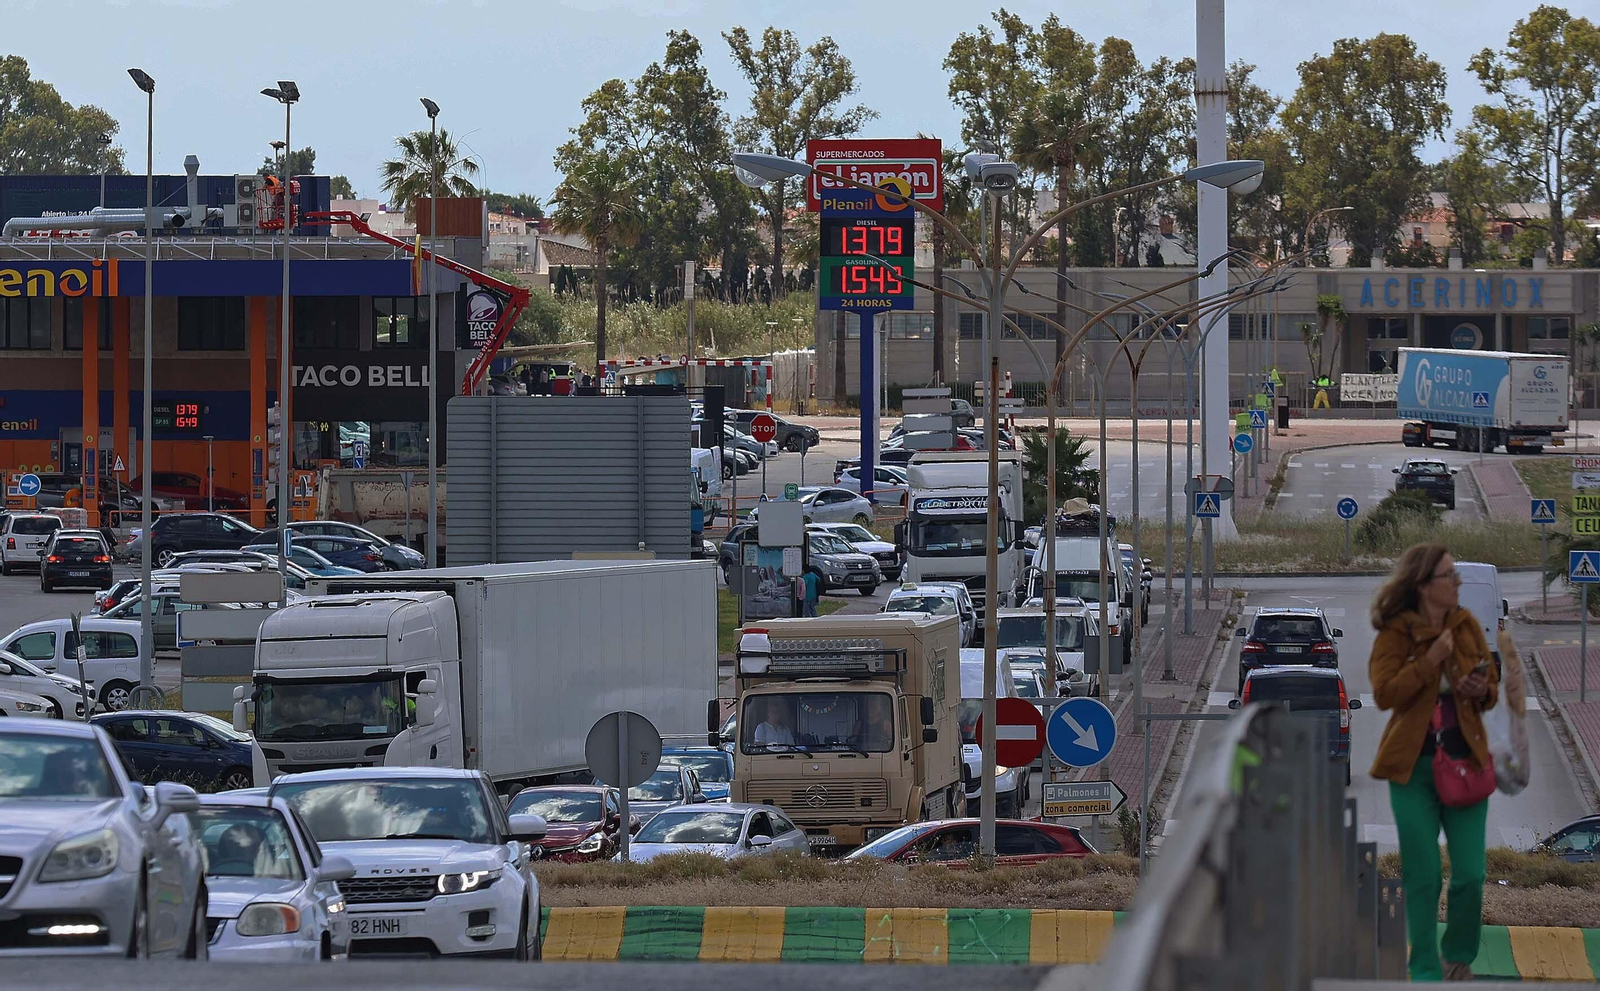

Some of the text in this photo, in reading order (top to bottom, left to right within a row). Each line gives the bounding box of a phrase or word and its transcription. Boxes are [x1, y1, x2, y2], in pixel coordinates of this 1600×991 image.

[821, 163, 929, 188] el jamón
[823, 199, 873, 210] Plenoil
[841, 226, 902, 254] 1.379
[841, 266, 902, 294] 1.549
[1360, 277, 1544, 308] ACERINOX
[841, 299, 892, 307] 24 HORAS
[468, 322, 498, 331] TACO
[292, 364, 362, 388] TACO
[1434, 366, 1472, 386] GRUPO
[1433, 389, 1472, 408] ALCAZA
[1574, 497, 1600, 510] TAN
[1057, 786, 1110, 798] Palmones II
[1045, 802, 1110, 813] zona comercial
[372, 918, 400, 934] HNH
